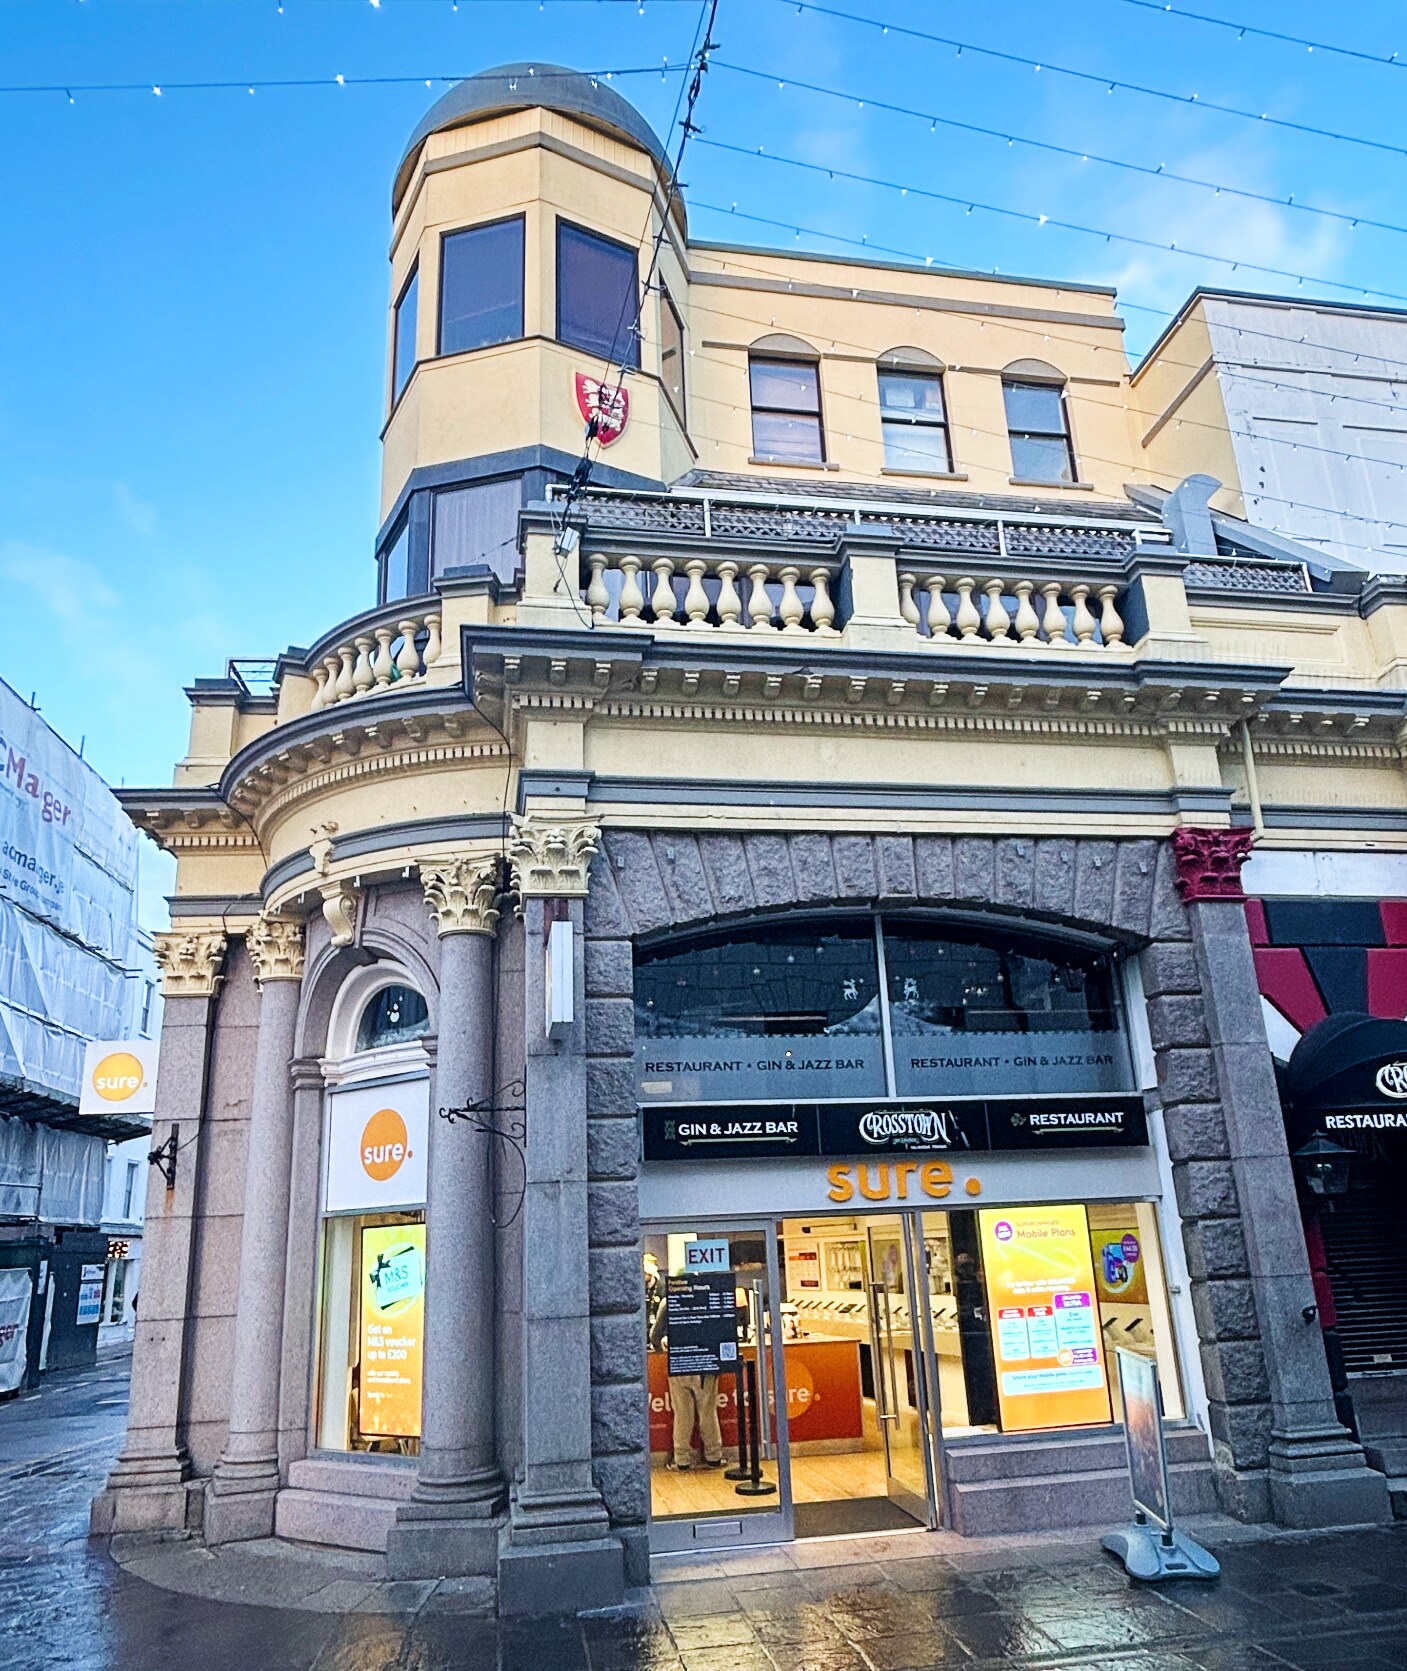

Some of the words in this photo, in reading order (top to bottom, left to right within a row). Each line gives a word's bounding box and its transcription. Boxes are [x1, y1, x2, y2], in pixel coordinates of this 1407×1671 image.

[645, 1061, 742, 1073] RESTAURANT
[757, 1060, 782, 1071] GIN
[785, 1060, 796, 1071] &
[798, 1059, 833, 1070] JAZZ
[835, 1059, 865, 1070] BAR
[911, 1057, 1000, 1069] RESTAURANT
[1013, 1056, 1038, 1067] GIN
[1040, 1056, 1049, 1066] &
[1052, 1055, 1082, 1066] JAZZ
[1087, 1055, 1114, 1065] BAR
[1376, 1063, 1407, 1098] CR
[1030, 1112, 1125, 1126] RESTAURANT
[1325, 1113, 1407, 1129] RESTAURA
[678, 1123, 707, 1136] GIN
[710, 1123, 722, 1135] &
[724, 1122, 763, 1135] JAZZ
[765, 1121, 799, 1134] BAR
[859, 1111, 952, 1144] CROSSTOWN
[1017, 1229, 1048, 1239] Mobile
[1051, 1228, 1076, 1237] Plans
[688, 1248, 725, 1264] EXIT
[384, 1264, 409, 1285] M&S
[367, 1324, 381, 1335] Get
[382, 1326, 393, 1335] an
[367, 1336, 385, 1347] M&S
[385, 1336, 417, 1347] voucher
[367, 1351, 377, 1361] up
[378, 1350, 386, 1360] to
